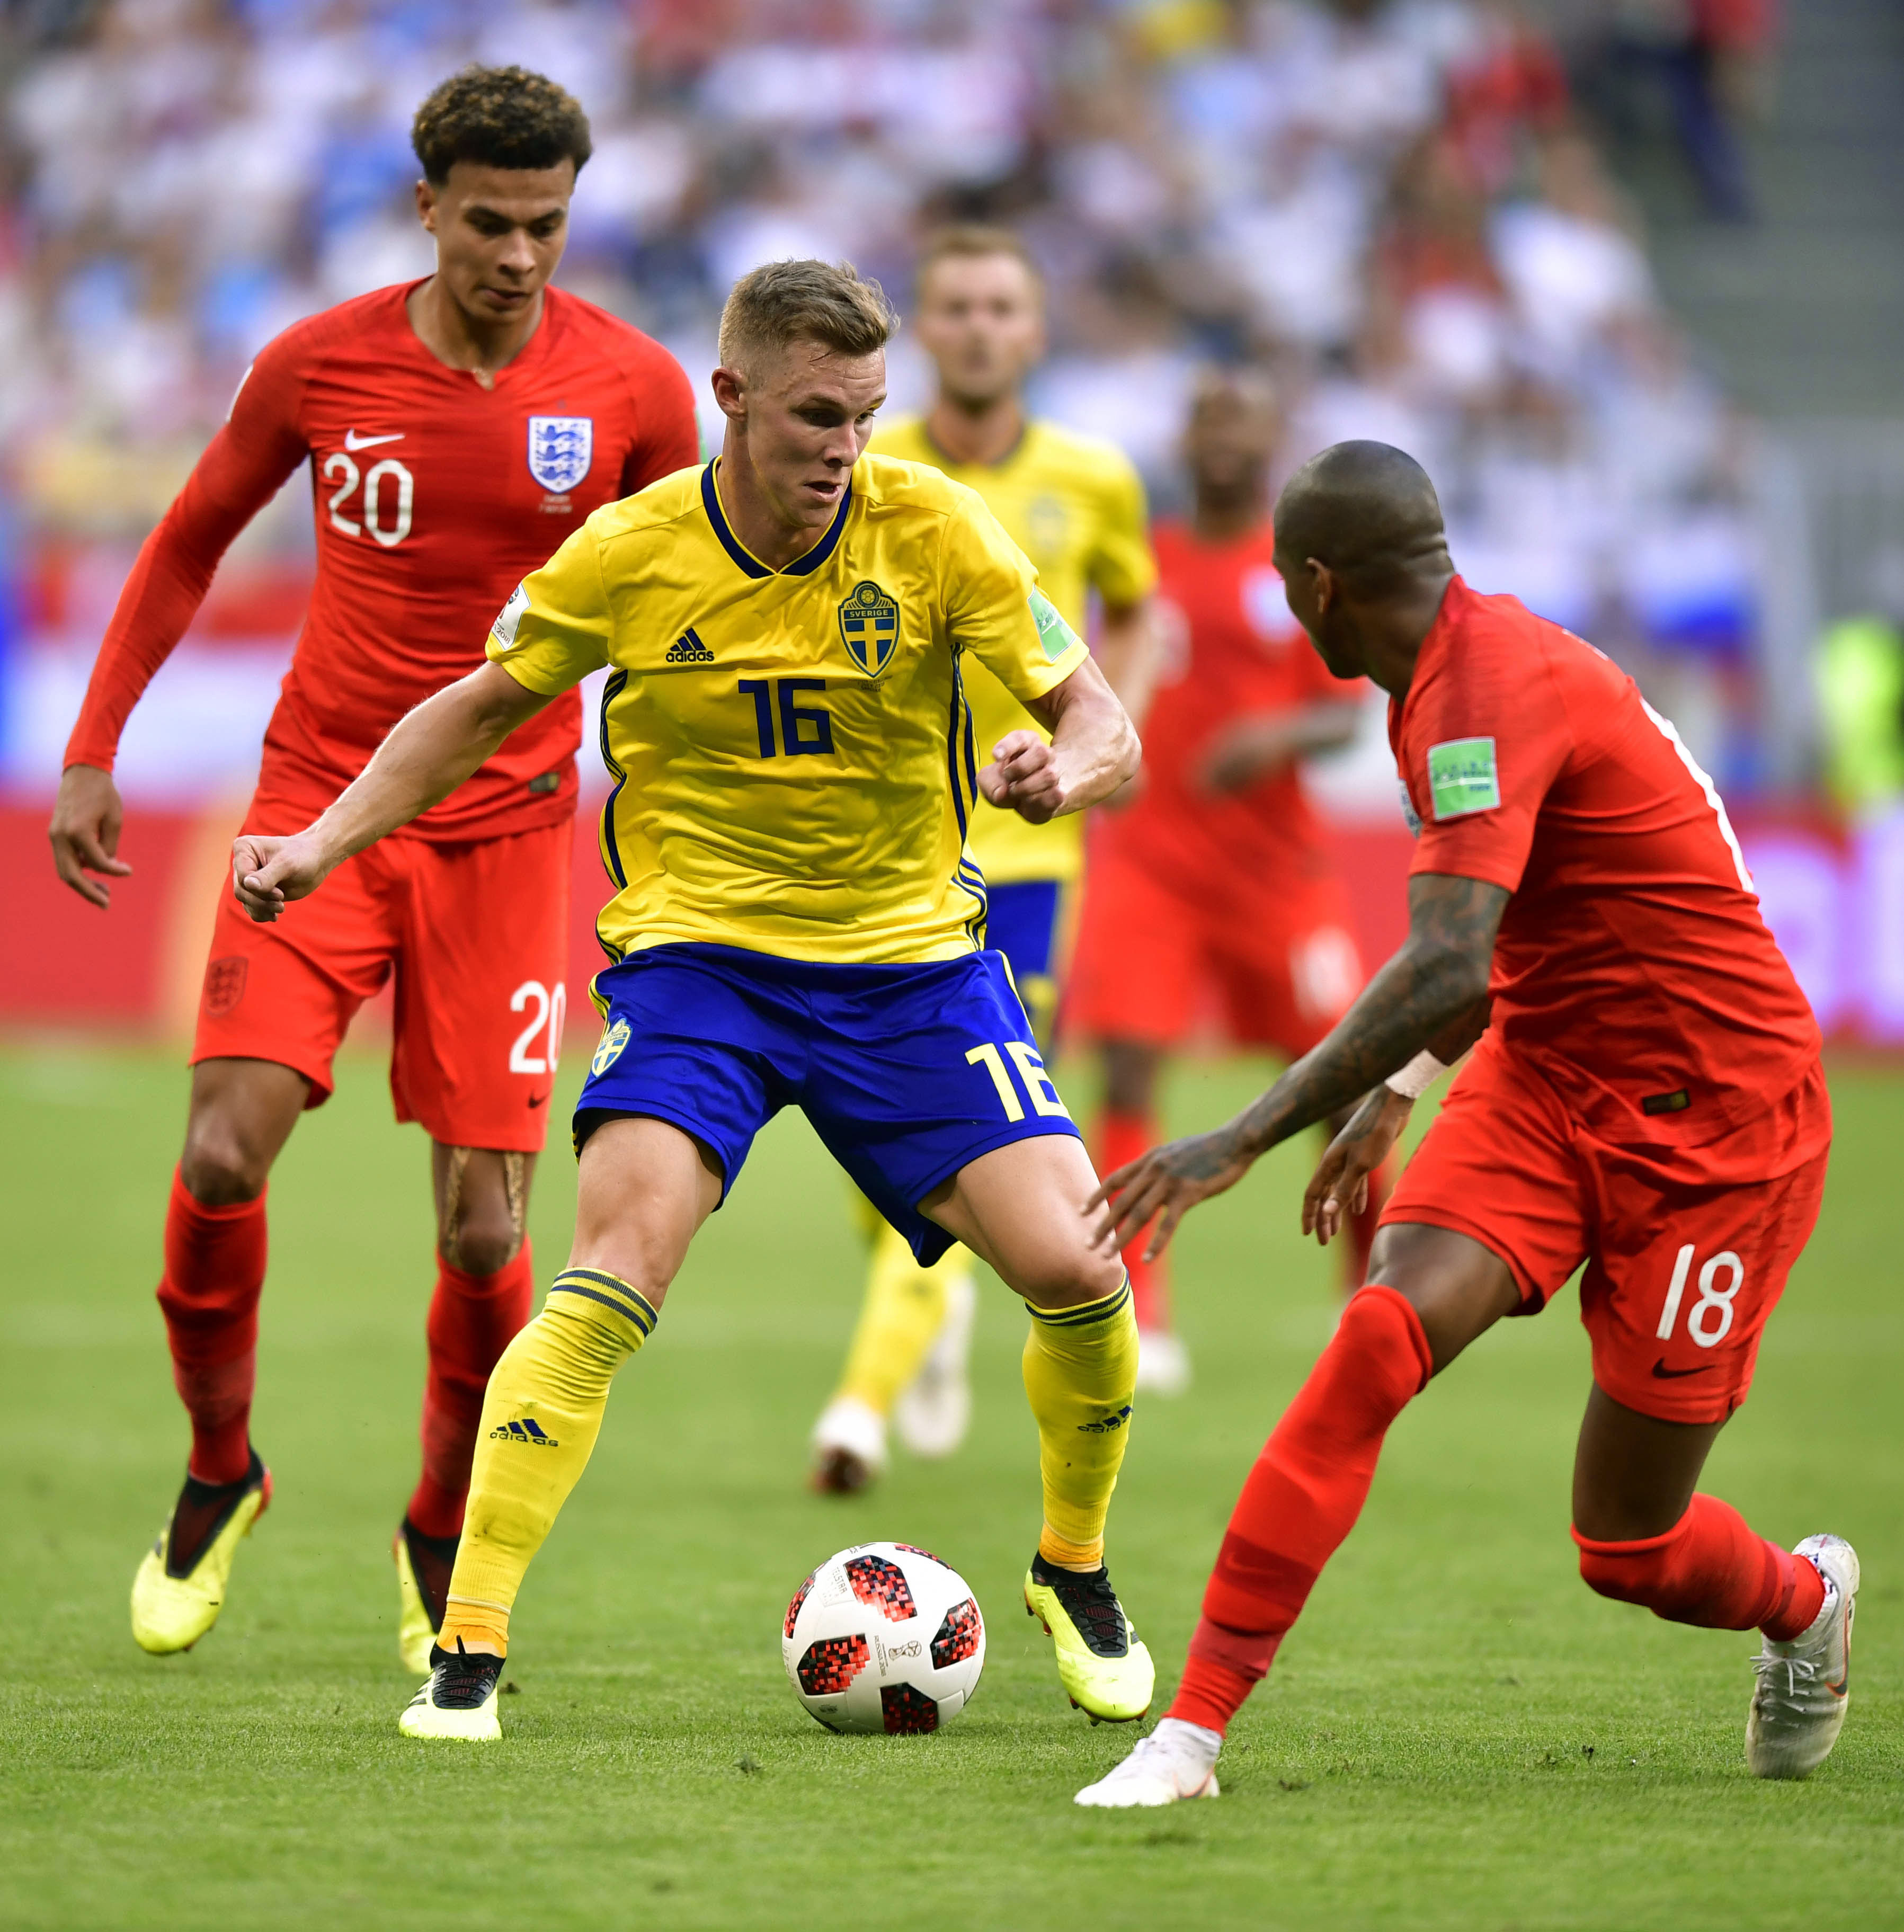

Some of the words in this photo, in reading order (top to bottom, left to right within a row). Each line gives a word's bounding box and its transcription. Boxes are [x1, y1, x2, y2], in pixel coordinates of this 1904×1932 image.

[324, 452, 414, 547] 20
[850, 609, 889, 618] SVERIGE
[496, 627, 511, 644] 2018
[665, 650, 715, 663] adidas
[738, 679, 835, 759] 16
[509, 980, 566, 1073] 20
[965, 1041, 1073, 1123] 16
[1656, 1243, 1745, 1348] 18
[1077, 1415, 1129, 1434] adid
[490, 1431, 559, 1447] adidas
[832, 1566, 848, 1594] TELSTAR
